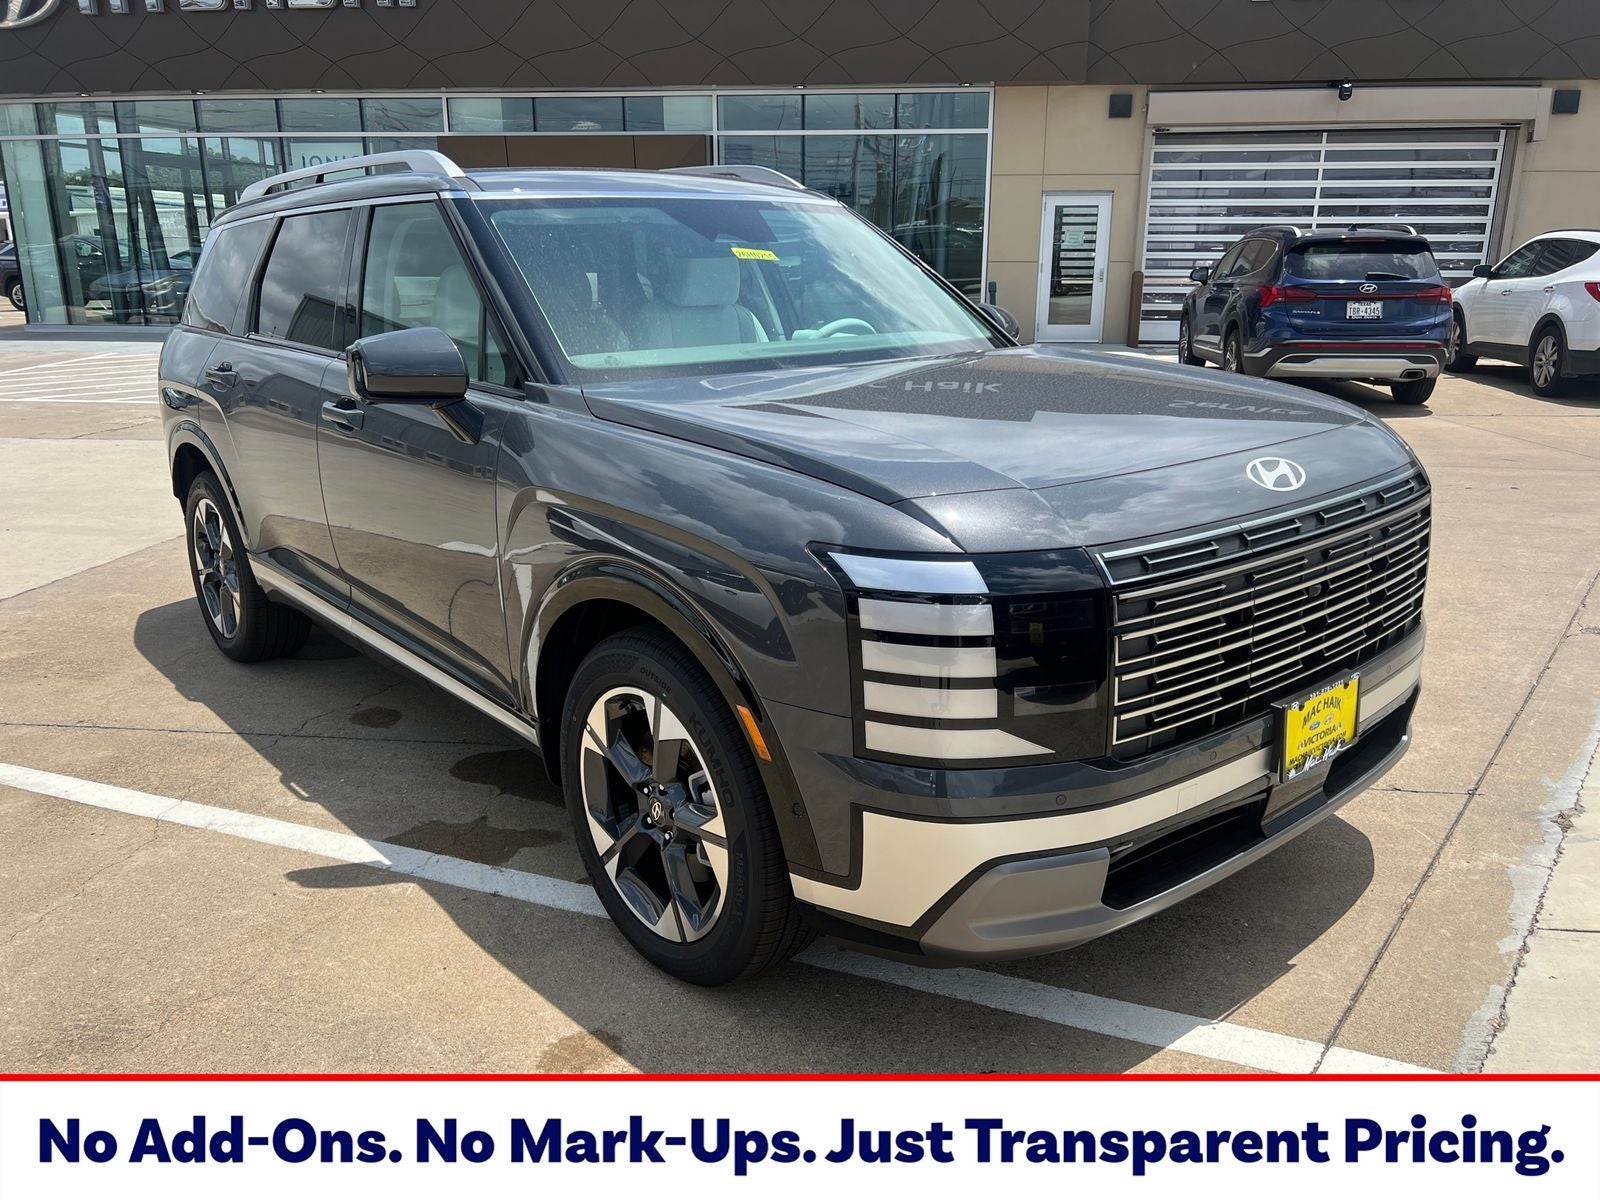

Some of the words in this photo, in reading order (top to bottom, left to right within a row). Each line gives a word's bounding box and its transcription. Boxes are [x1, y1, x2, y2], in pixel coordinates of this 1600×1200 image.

[640, 667, 672, 694] OUTSIDE
[1302, 700, 1322, 726] MAC
[1323, 696, 1342, 711] HAIK
[689, 711, 735, 809] KUMHO
